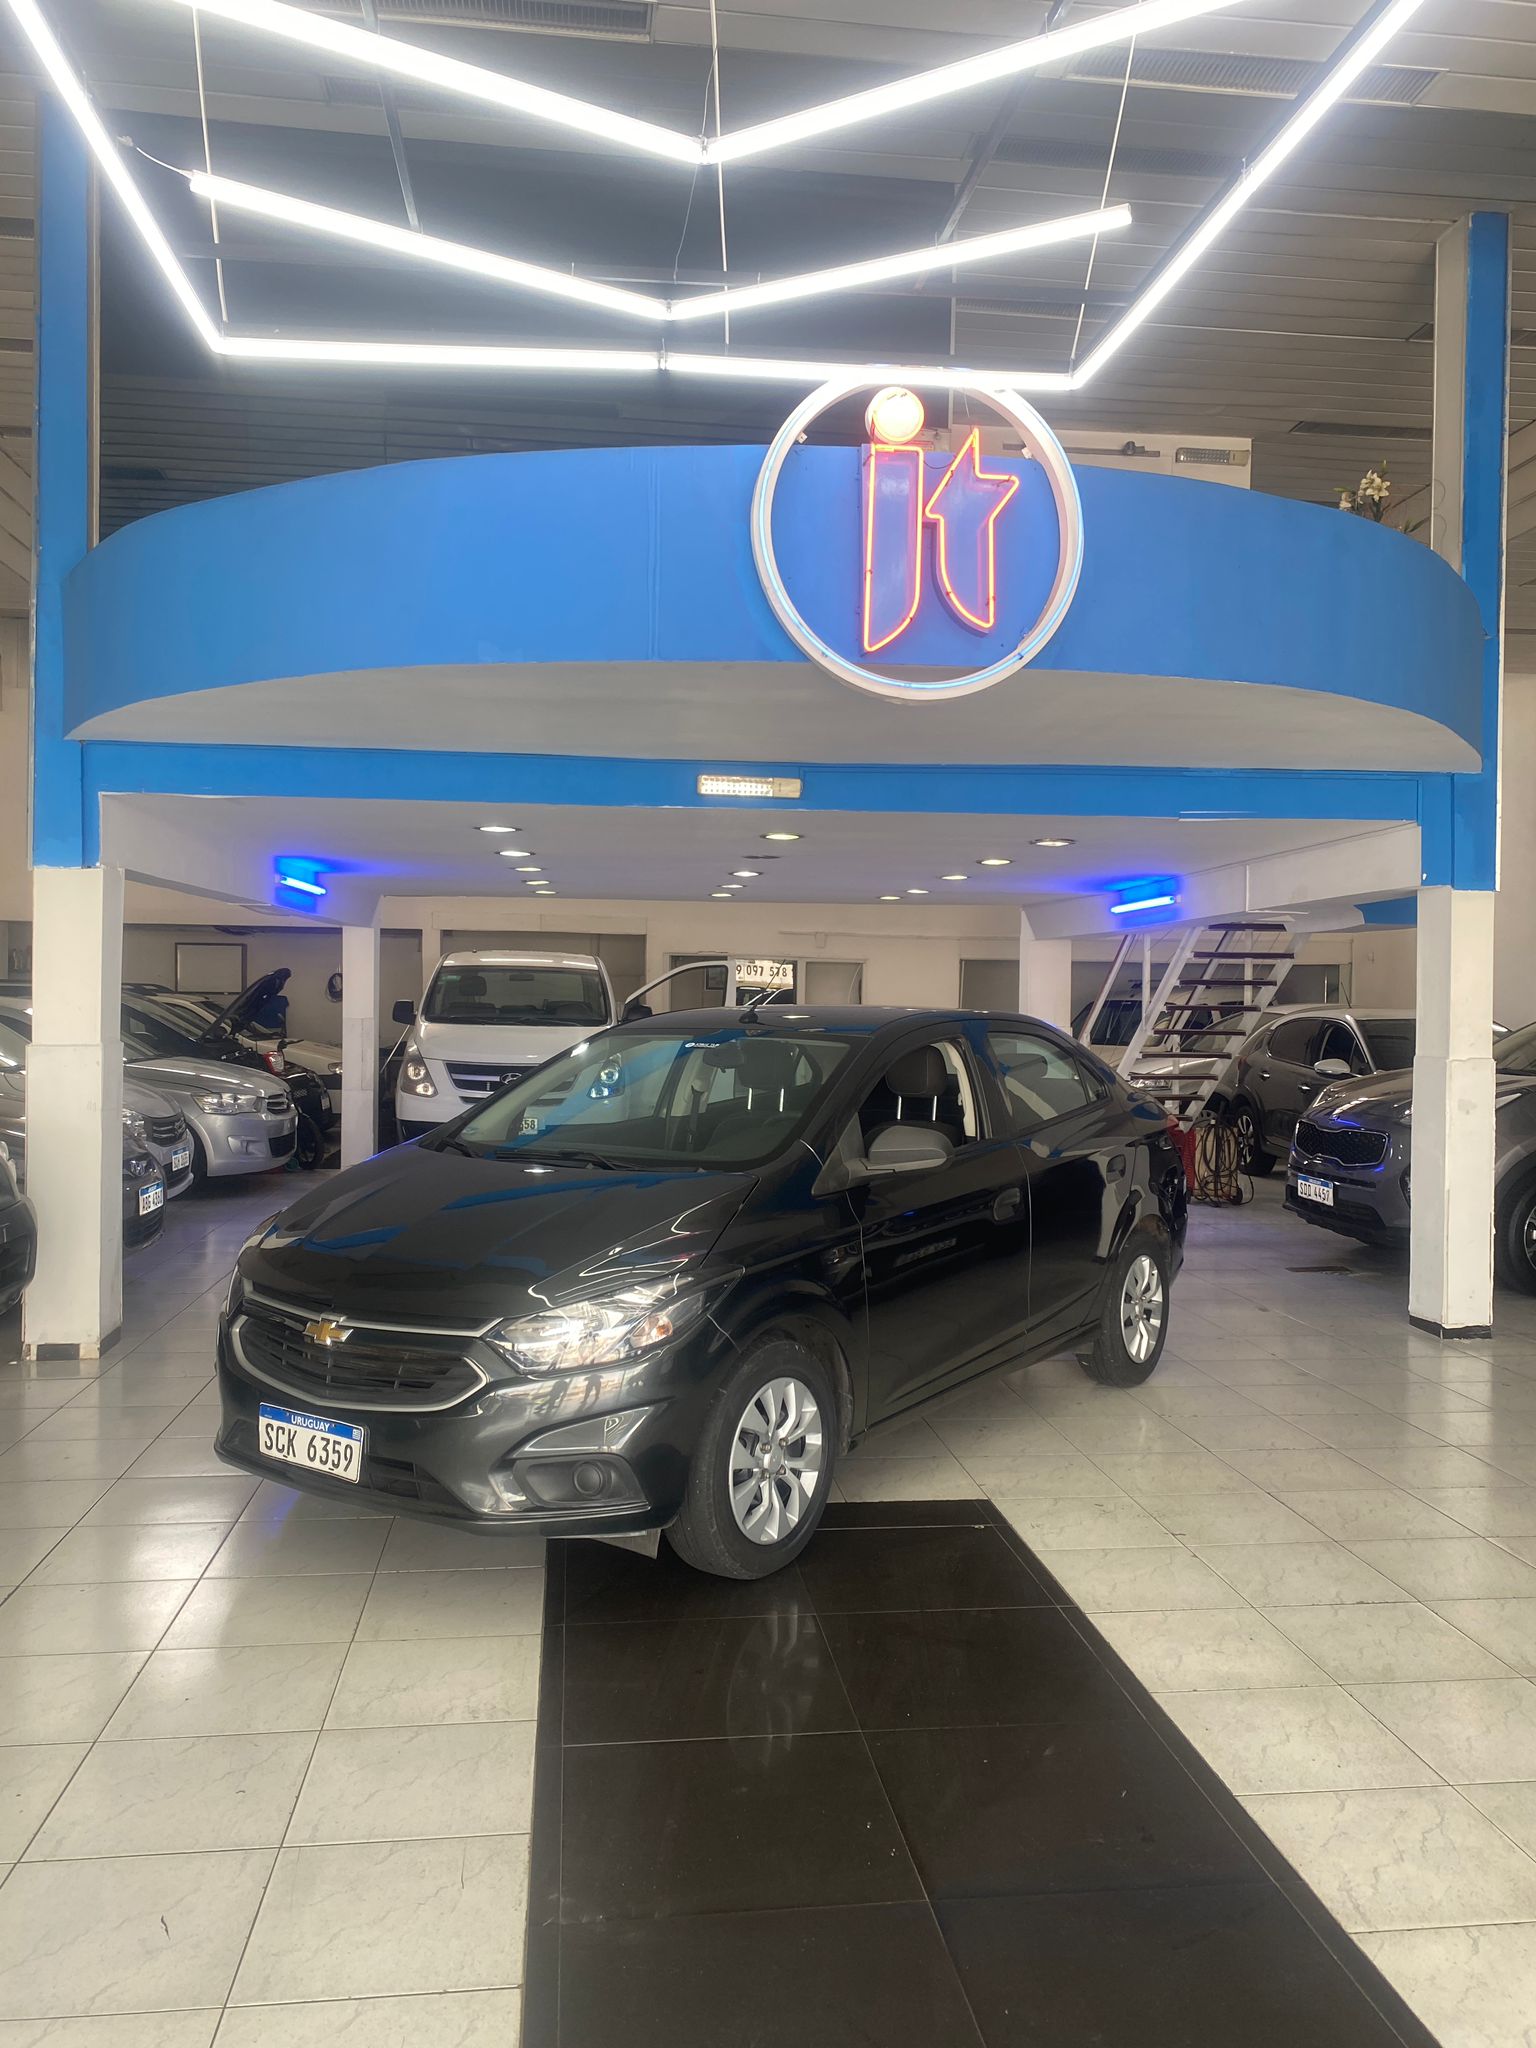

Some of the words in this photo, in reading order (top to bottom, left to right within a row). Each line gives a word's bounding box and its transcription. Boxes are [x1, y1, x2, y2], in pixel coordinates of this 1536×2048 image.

[746, 964, 764, 977] 097
[769, 966, 788, 977] 578
[291, 1414, 331, 1432] URUGUAY
[264, 1422, 297, 1458] SCK
[307, 1434, 354, 1473] 6359
